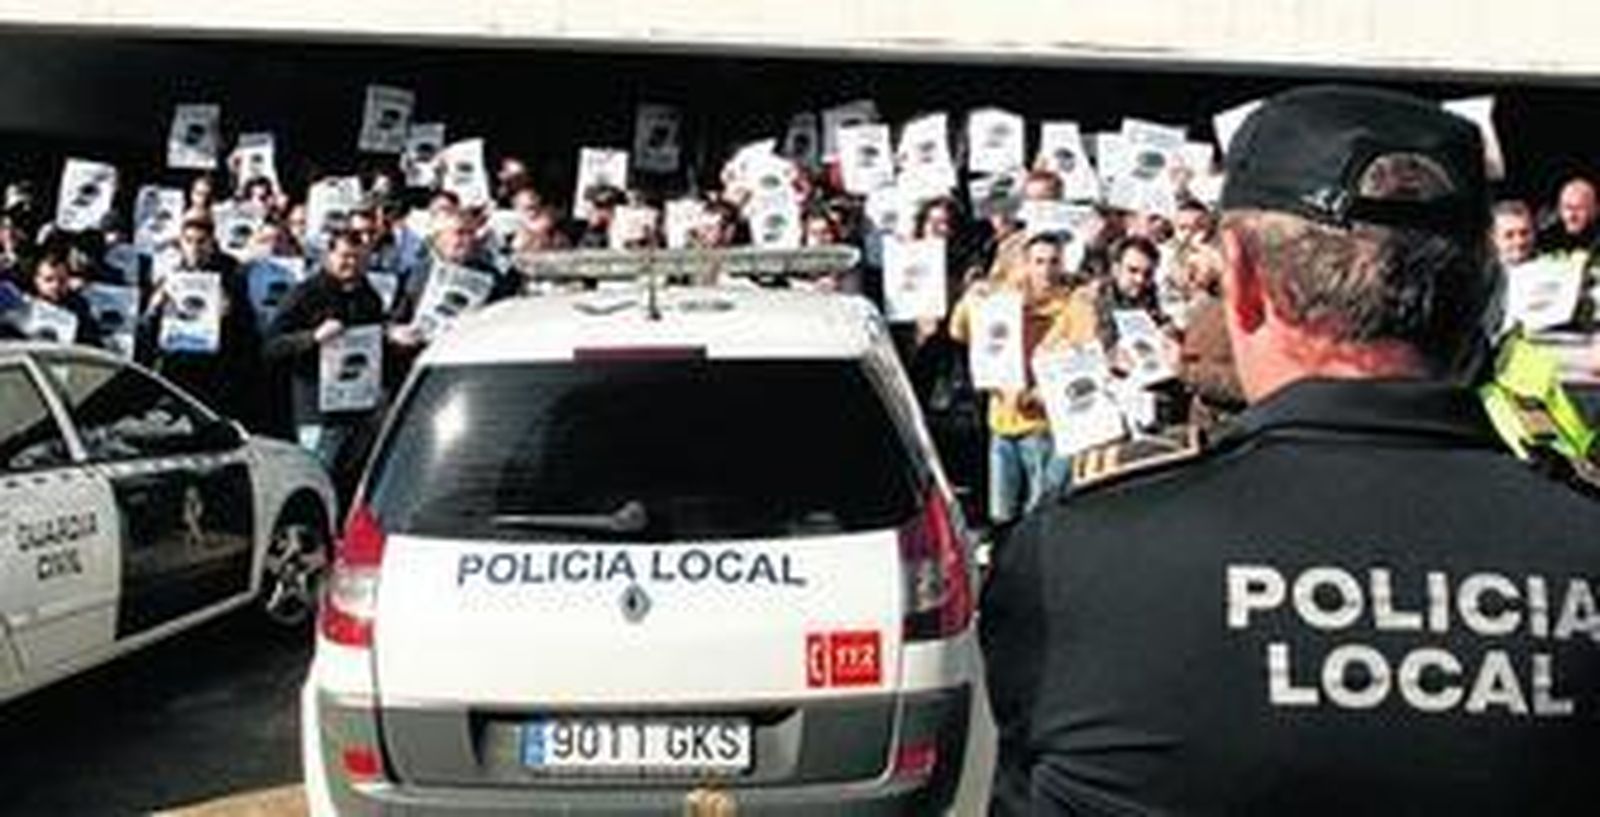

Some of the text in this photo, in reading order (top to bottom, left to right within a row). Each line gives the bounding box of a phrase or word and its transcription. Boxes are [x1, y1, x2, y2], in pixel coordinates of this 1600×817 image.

[17, 510, 99, 553] GUARDIA
[36, 547, 83, 581] CIVIL
[456, 548, 807, 588] POLICIA LOCAL
[1226, 564, 1600, 642] POLICIA
[836, 644, 877, 668] 112
[1266, 642, 1573, 716] LOCAL
[553, 719, 648, 760] 9011
[666, 721, 742, 761] GKS
